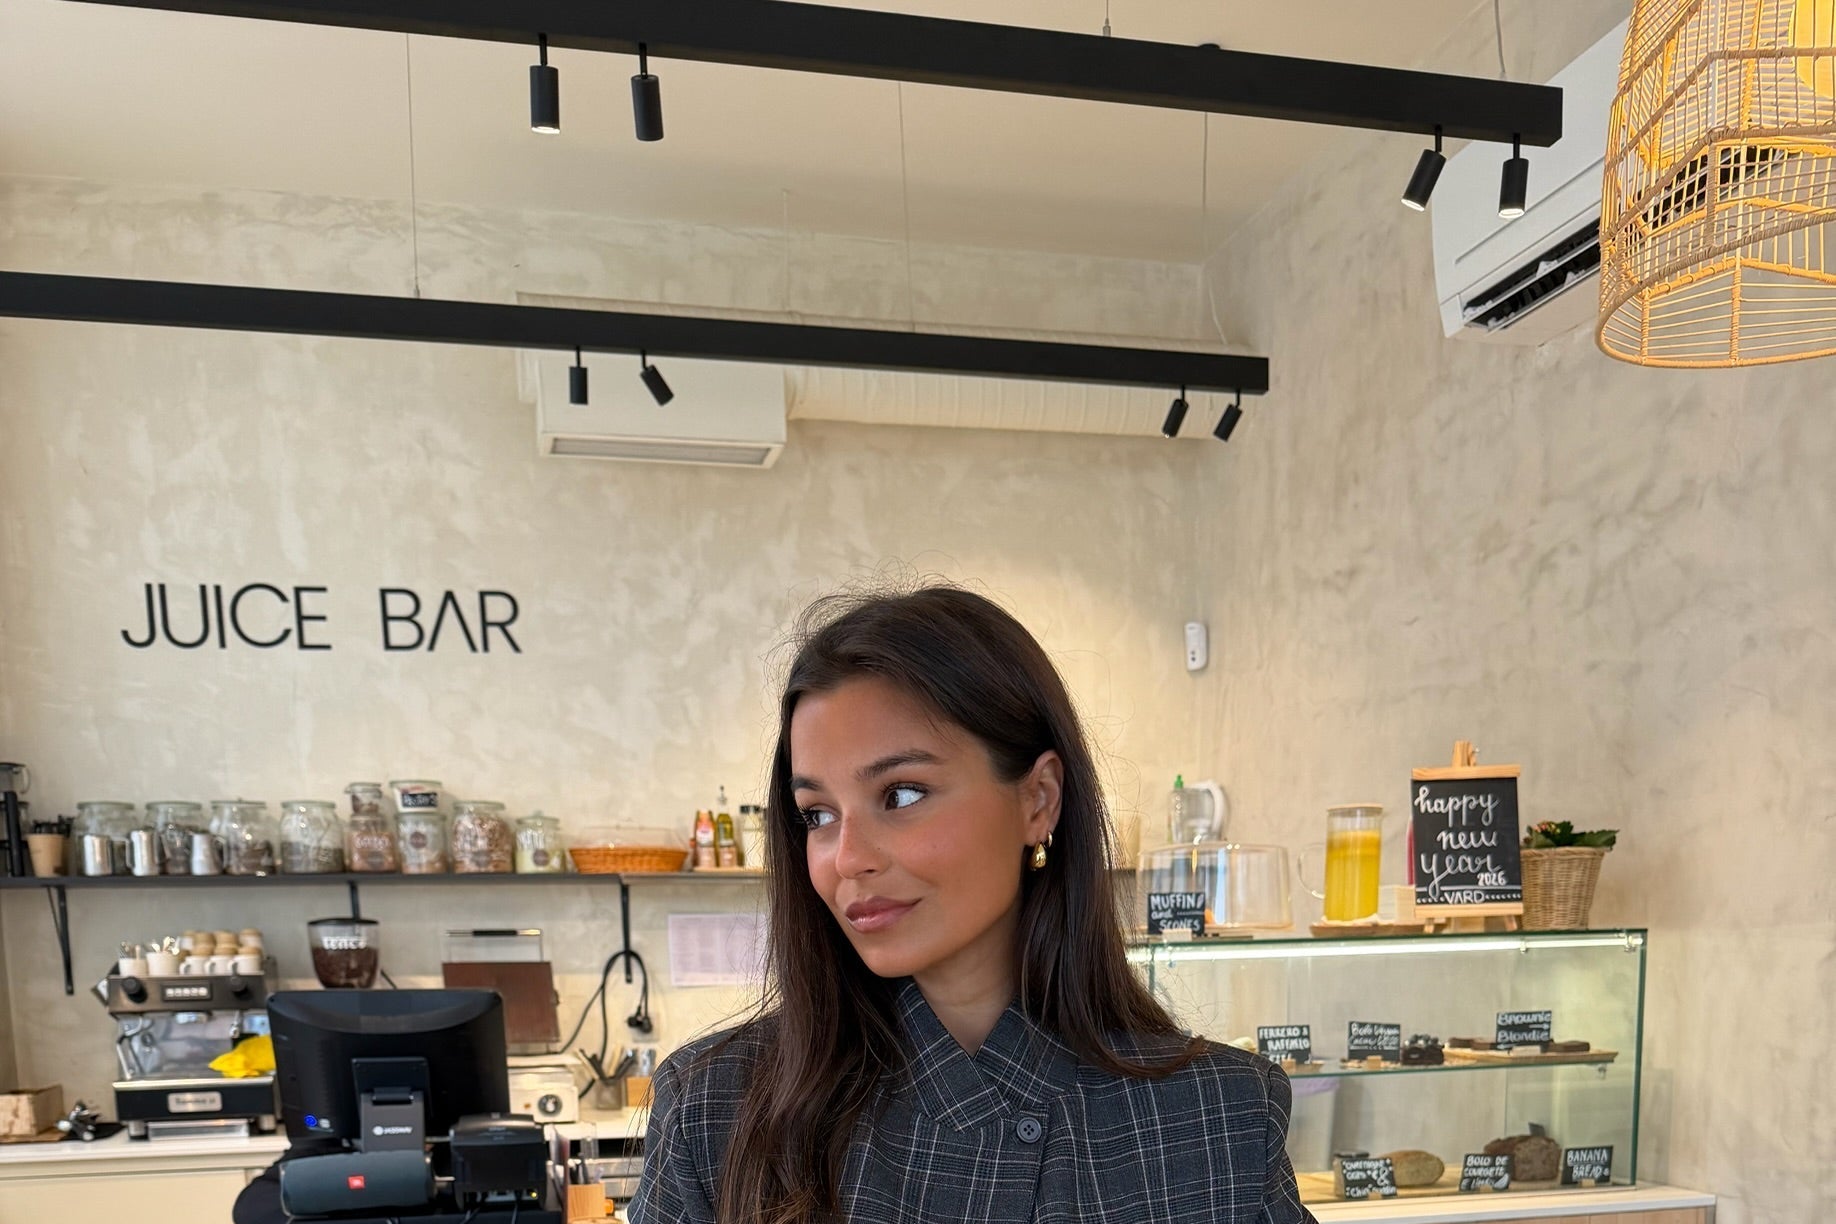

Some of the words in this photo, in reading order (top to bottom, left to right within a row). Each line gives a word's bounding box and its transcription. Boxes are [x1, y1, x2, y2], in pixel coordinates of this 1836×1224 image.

[121, 582, 333, 651] JUICE
[378, 587, 523, 654] BAR
[1414, 785, 1500, 828] happy
[1436, 830, 1498, 850] new
[1420, 852, 1502, 901] year
[1476, 871, 1507, 886] 2026
[1151, 908, 1173, 920] and
[1466, 1155, 1491, 1167] BOLO
[1495, 1155, 1509, 1166] DE
[1567, 1148, 1608, 1165] BANANA
